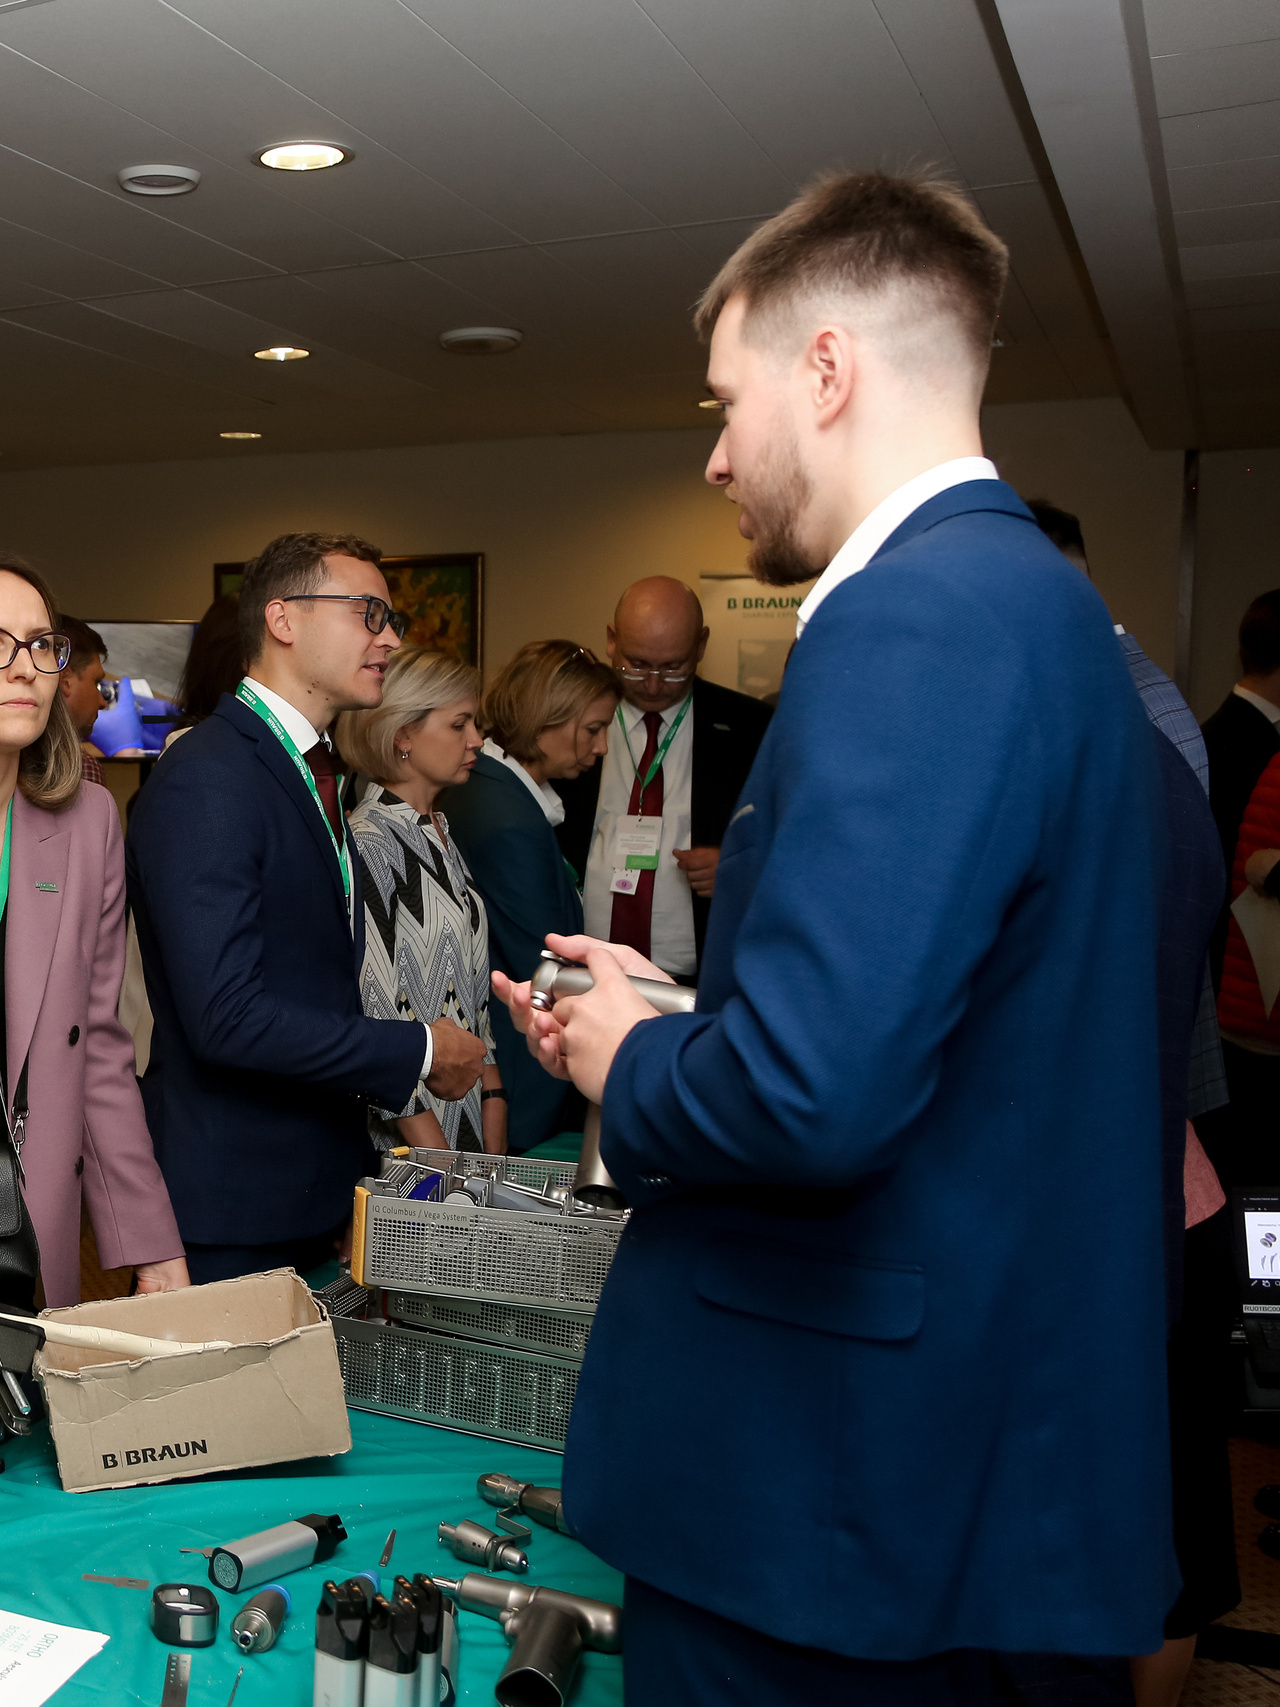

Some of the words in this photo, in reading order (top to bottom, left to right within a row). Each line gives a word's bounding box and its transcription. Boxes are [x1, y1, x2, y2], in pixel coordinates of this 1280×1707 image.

[727, 598, 737, 609] B
[743, 597, 802, 609] BRAUN
[372, 1204, 380, 1213] IQ
[382, 1205, 416, 1217] Columbus
[423, 1210, 440, 1220] Vega
[442, 1212, 468, 1222] System
[101, 1453, 119, 1469] B
[124, 1439, 208, 1466] BRAUN
[26, 1633, 58, 1658] ORTHO
